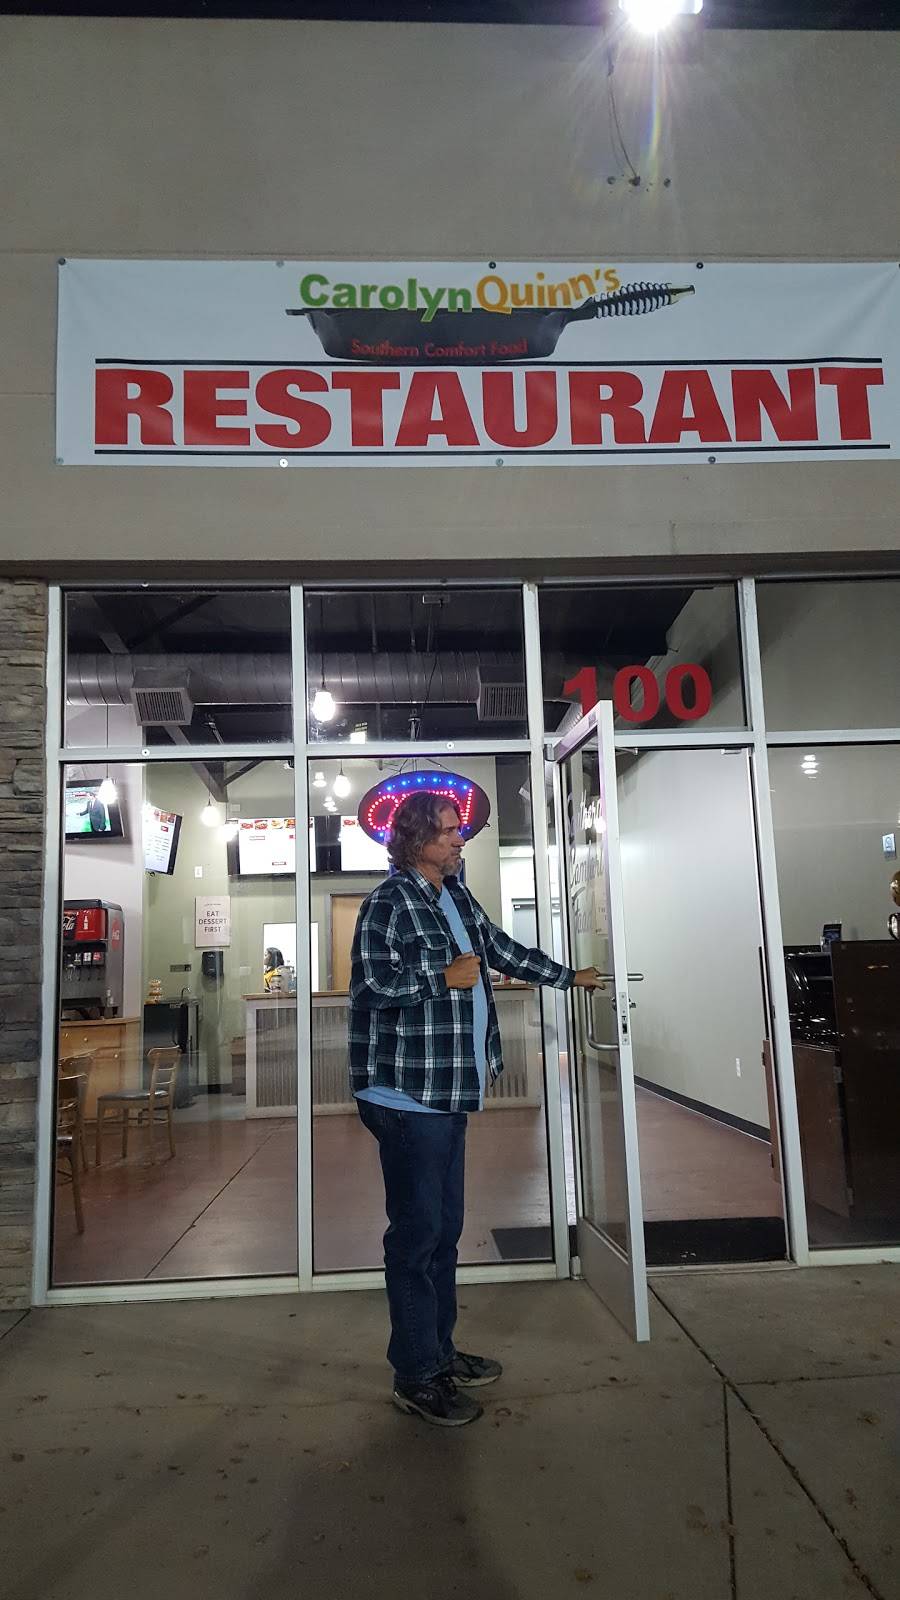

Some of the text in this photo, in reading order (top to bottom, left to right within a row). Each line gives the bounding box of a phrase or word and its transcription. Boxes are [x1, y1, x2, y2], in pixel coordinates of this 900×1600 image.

[300, 268, 620, 323] Carolyn Quinn's
[351, 338, 528, 357] Southern Comfort Food
[95, 367, 883, 449] RESTAURANT
[562, 663, 712, 722] 100
[206, 910, 220, 918] EAT
